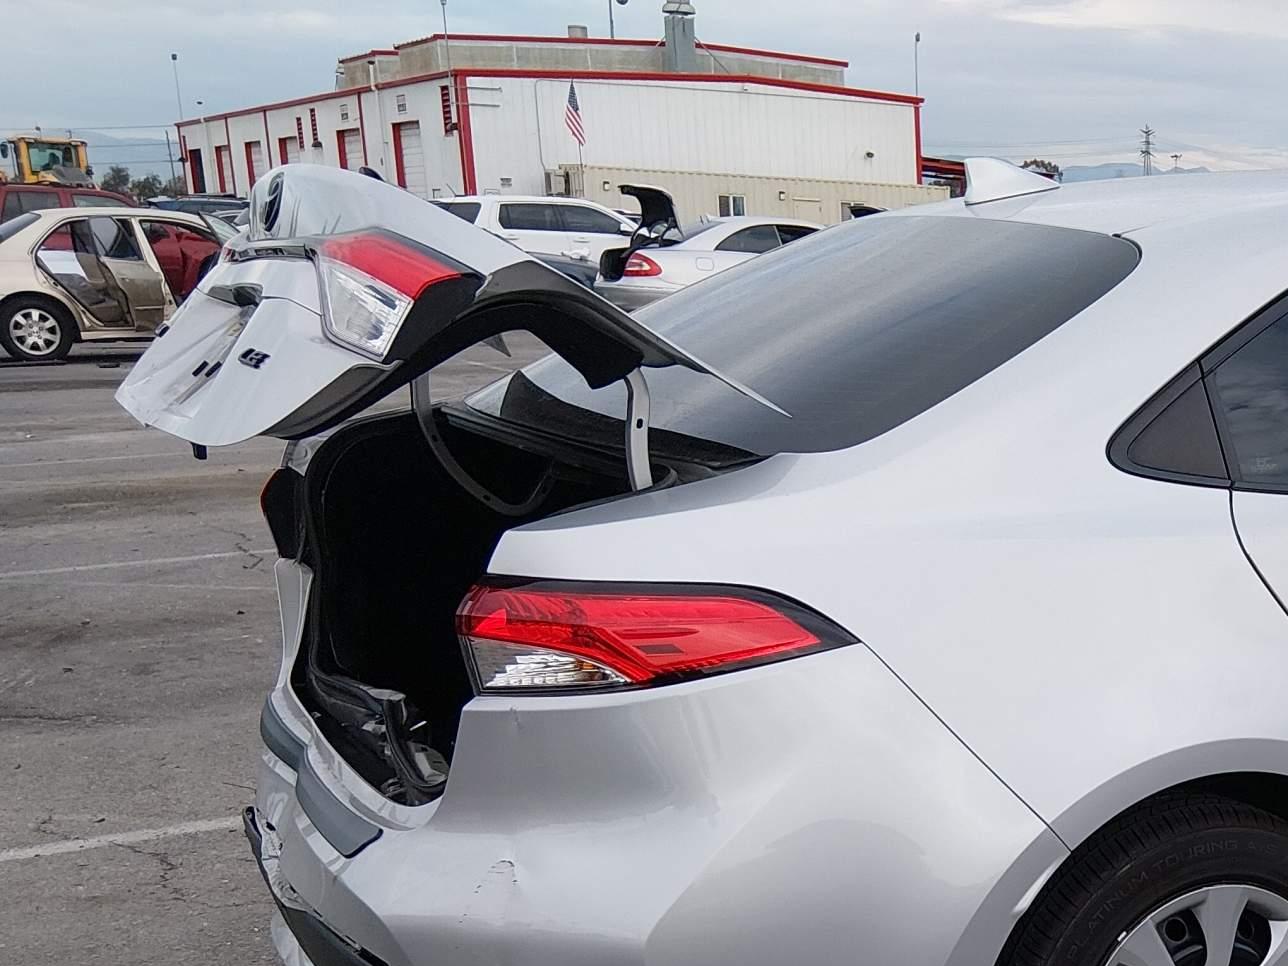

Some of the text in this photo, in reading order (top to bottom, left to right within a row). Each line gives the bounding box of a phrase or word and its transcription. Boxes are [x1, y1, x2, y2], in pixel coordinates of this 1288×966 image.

[1066, 839, 1279, 961] PLATINUM TOURING AS
